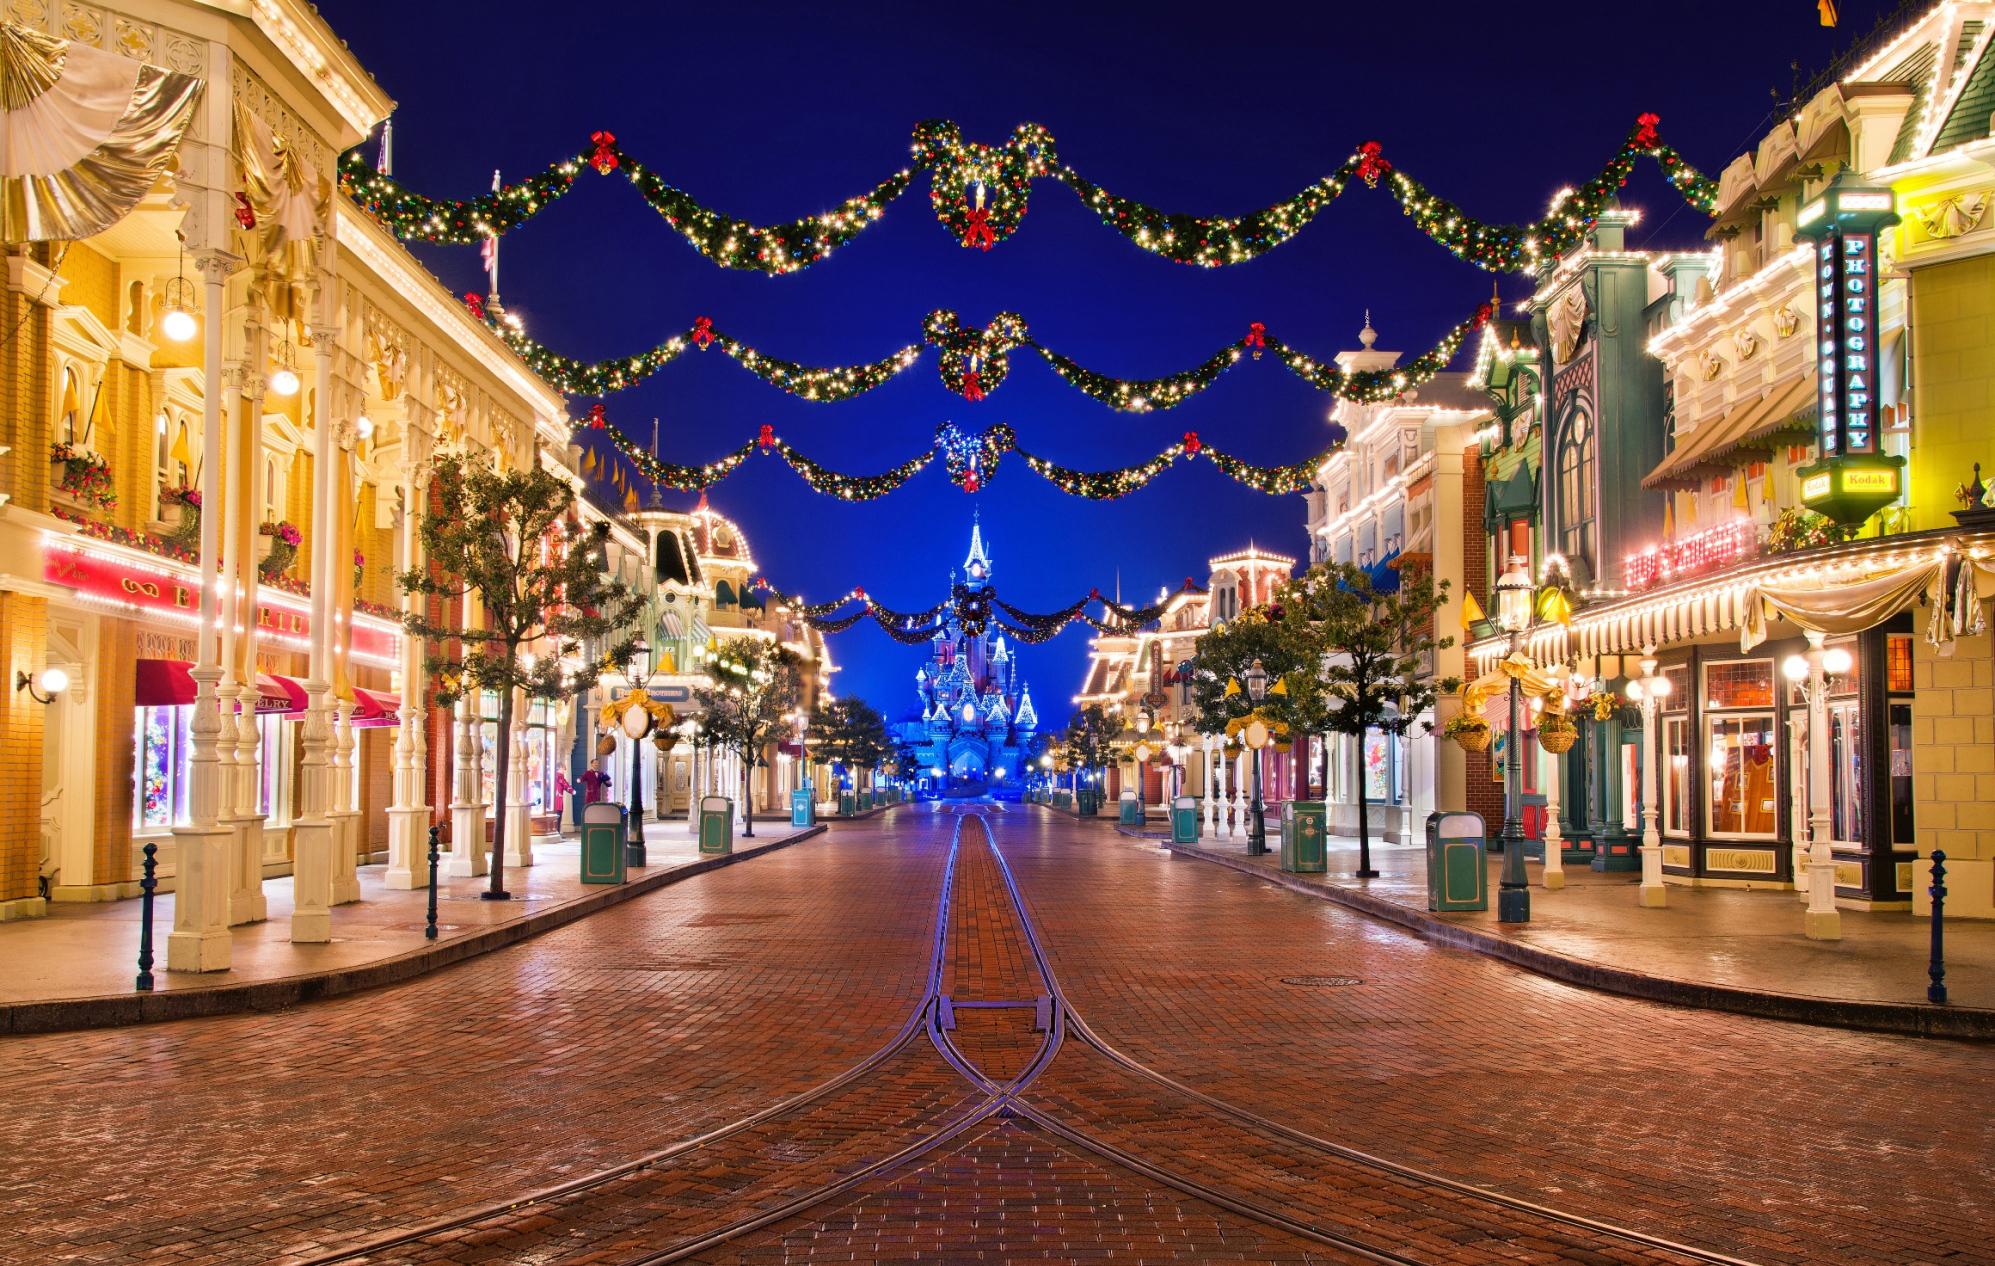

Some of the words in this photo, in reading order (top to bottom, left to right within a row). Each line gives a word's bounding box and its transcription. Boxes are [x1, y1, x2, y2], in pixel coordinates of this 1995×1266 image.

[1821, 243, 1834, 318] TOWN
[1845, 239, 1868, 448] PHOTOGRAPHY
[1822, 340, 1837, 450] SQUARE
[1849, 474, 1886, 485] Kodak
